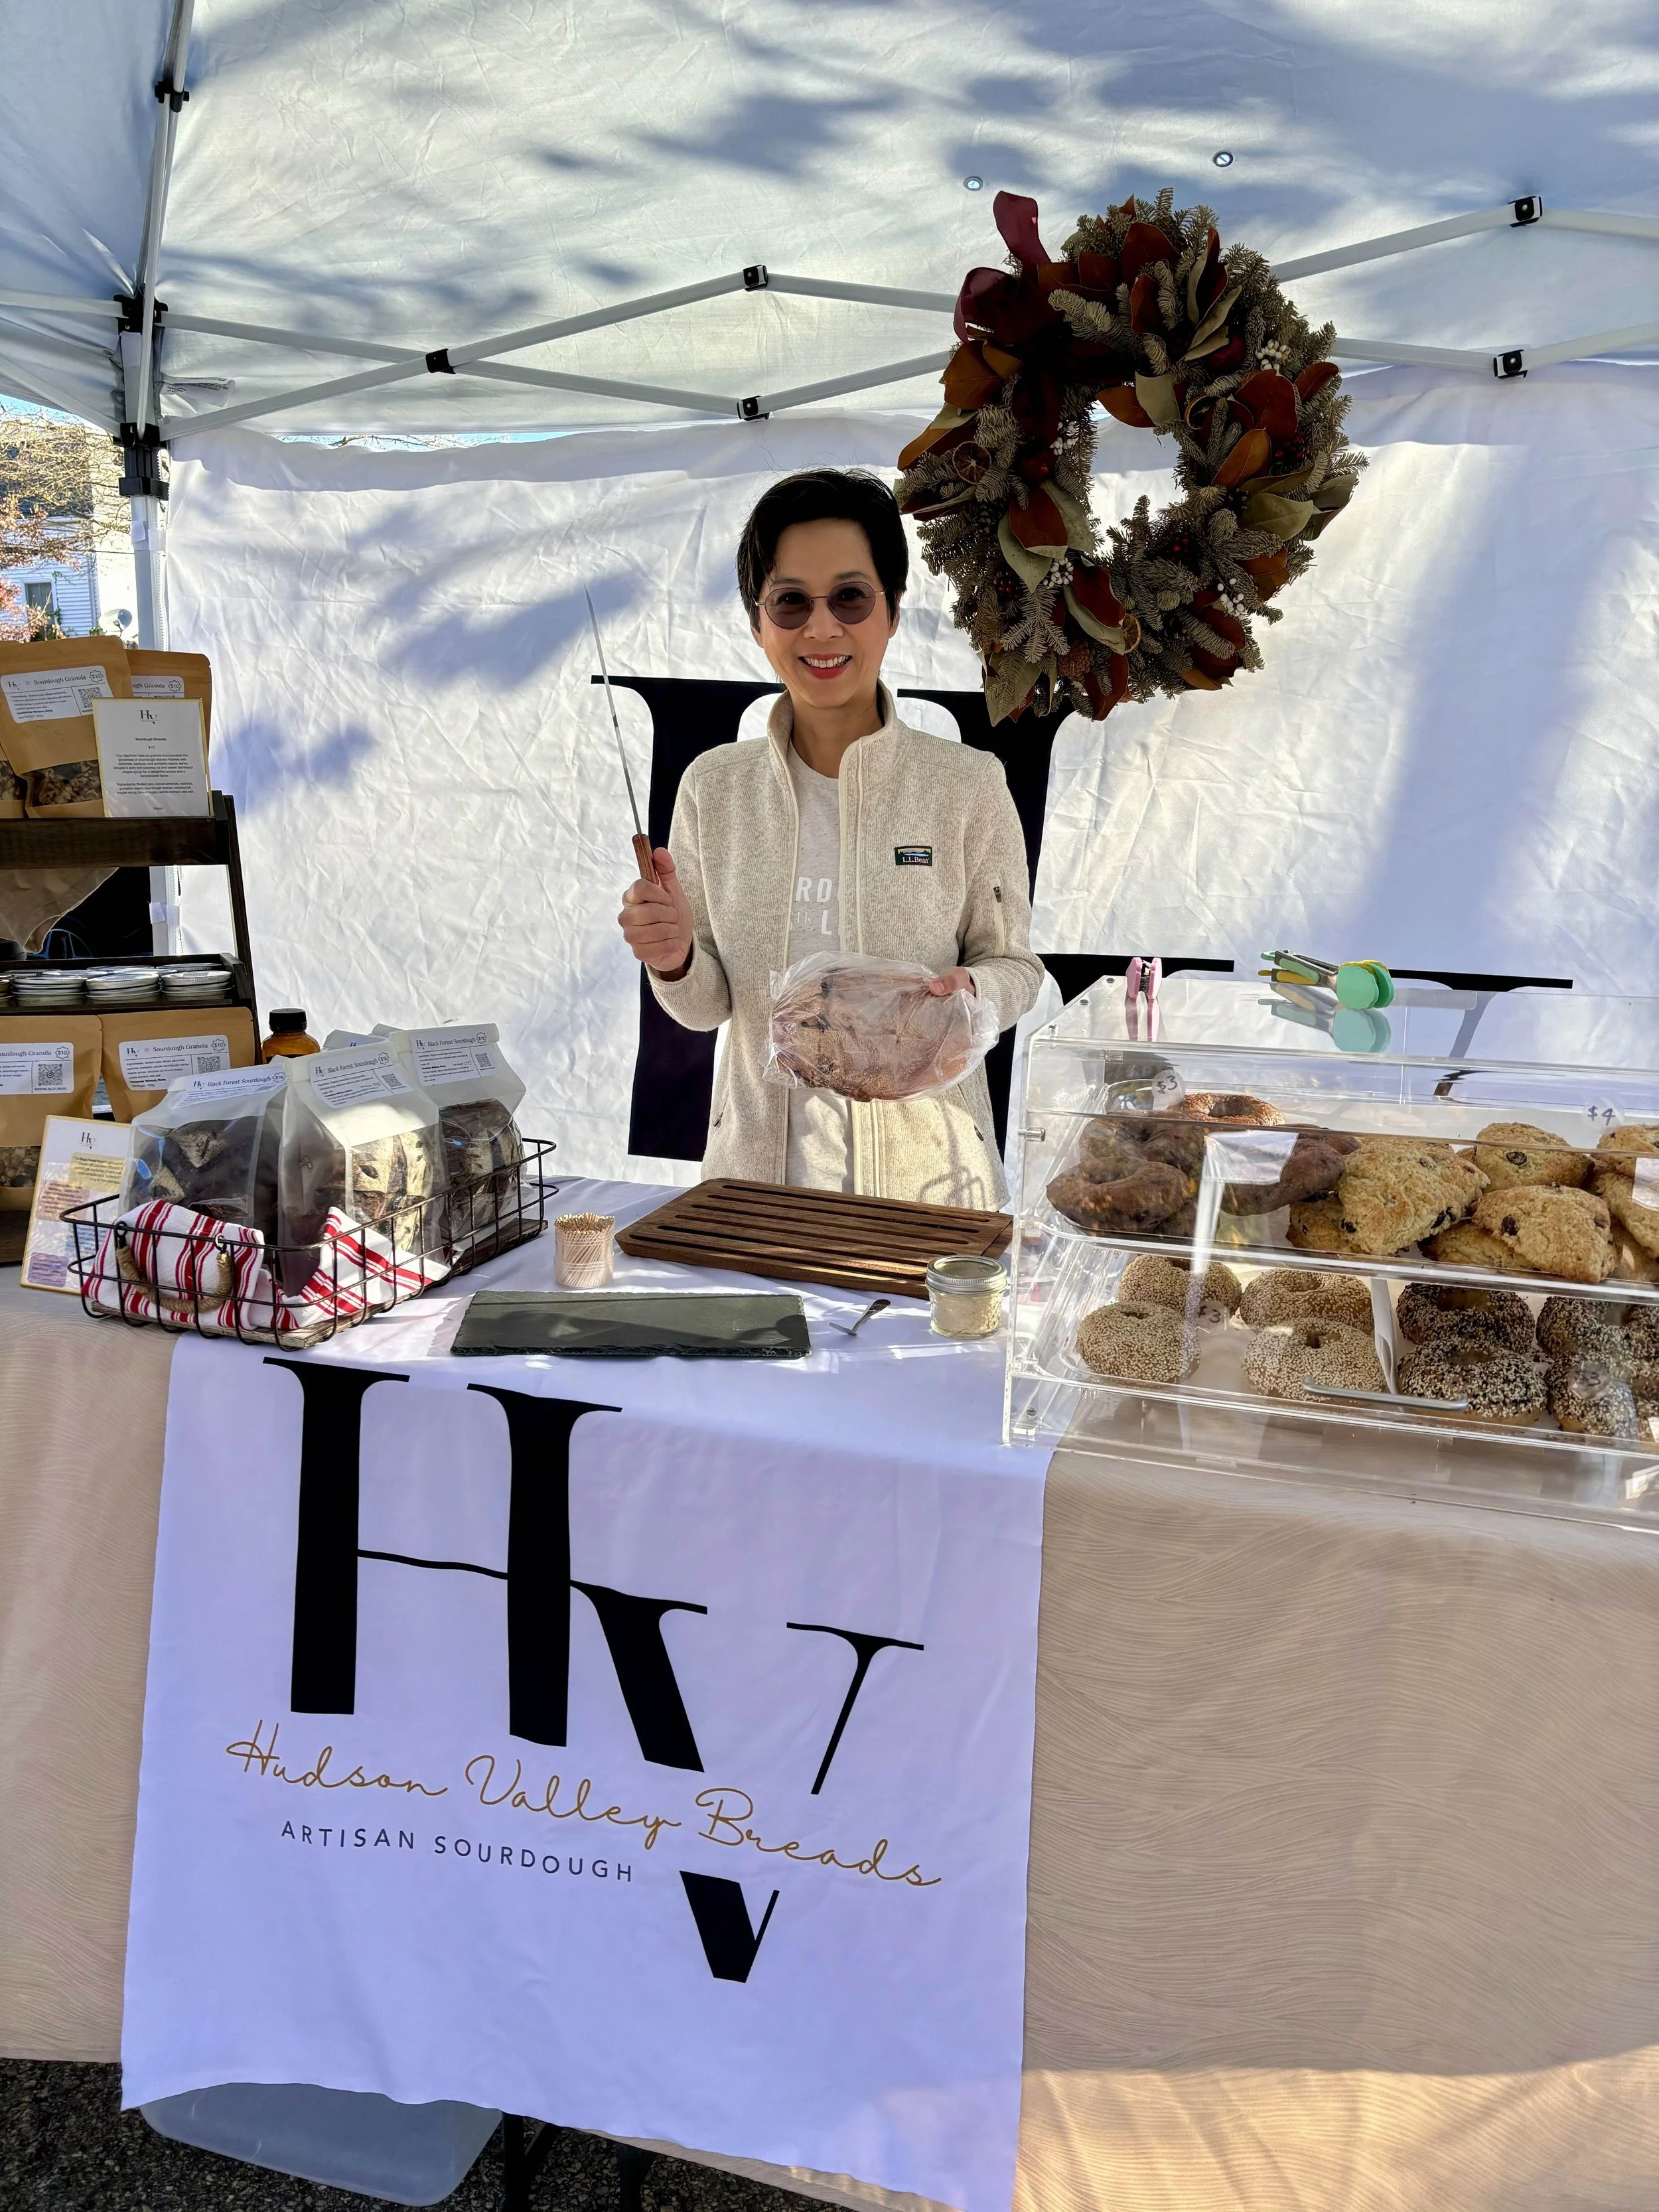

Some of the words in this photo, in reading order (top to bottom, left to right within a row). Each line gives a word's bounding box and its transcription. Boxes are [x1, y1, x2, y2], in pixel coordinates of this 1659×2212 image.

[1156, 1074, 1178, 1094] $3
[1587, 1105, 1616, 1126] $4
[226, 1719, 449, 1797] Hudson
[464, 1754, 682, 1850] Valley
[693, 1786, 942, 1887] Breads
[280, 1820, 415, 1850] ARTISAN
[433, 1835, 632, 1883] SOURDOUGH
